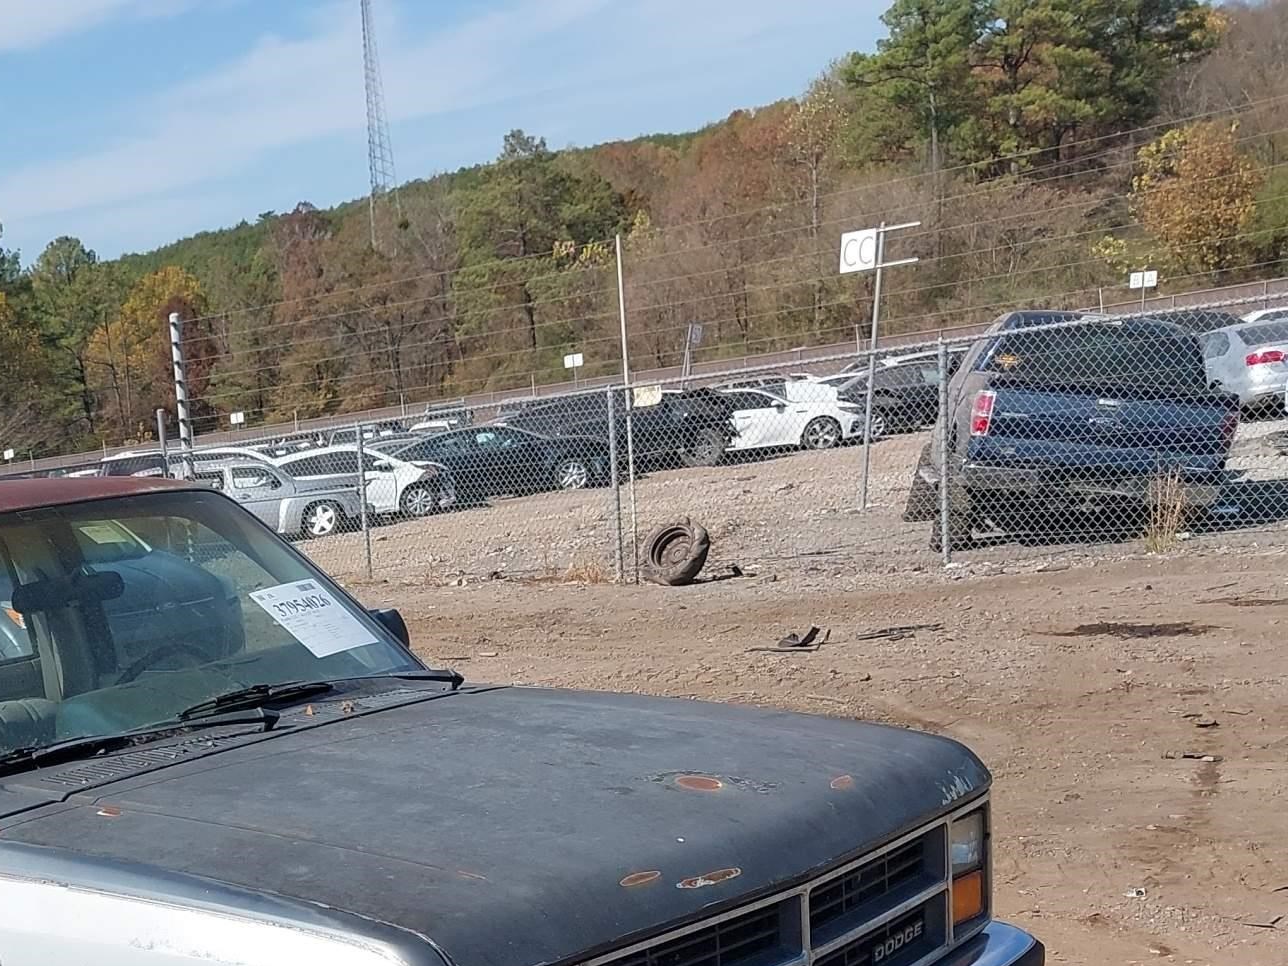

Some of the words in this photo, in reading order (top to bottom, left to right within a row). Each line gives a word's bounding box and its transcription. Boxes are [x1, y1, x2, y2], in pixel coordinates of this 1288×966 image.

[843, 235, 874, 268] CC
[272, 594, 332, 617] 37954026
[874, 920, 924, 962] DODGE
